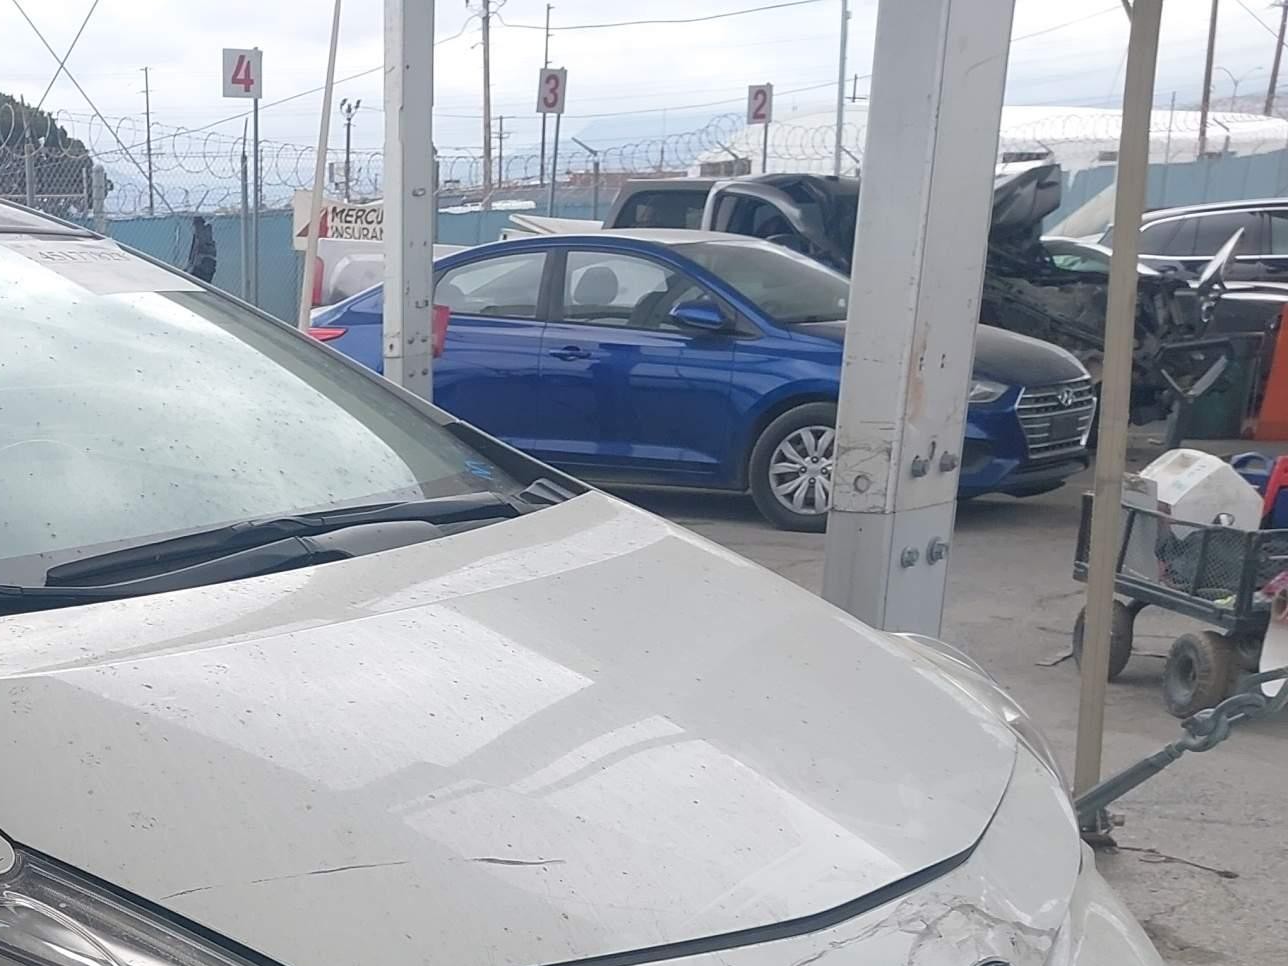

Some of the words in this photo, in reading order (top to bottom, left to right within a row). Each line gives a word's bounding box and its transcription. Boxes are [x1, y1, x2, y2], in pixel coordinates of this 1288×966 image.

[231, 54, 255, 93] 4
[543, 74, 560, 108] 3
[752, 88, 767, 120] 2
